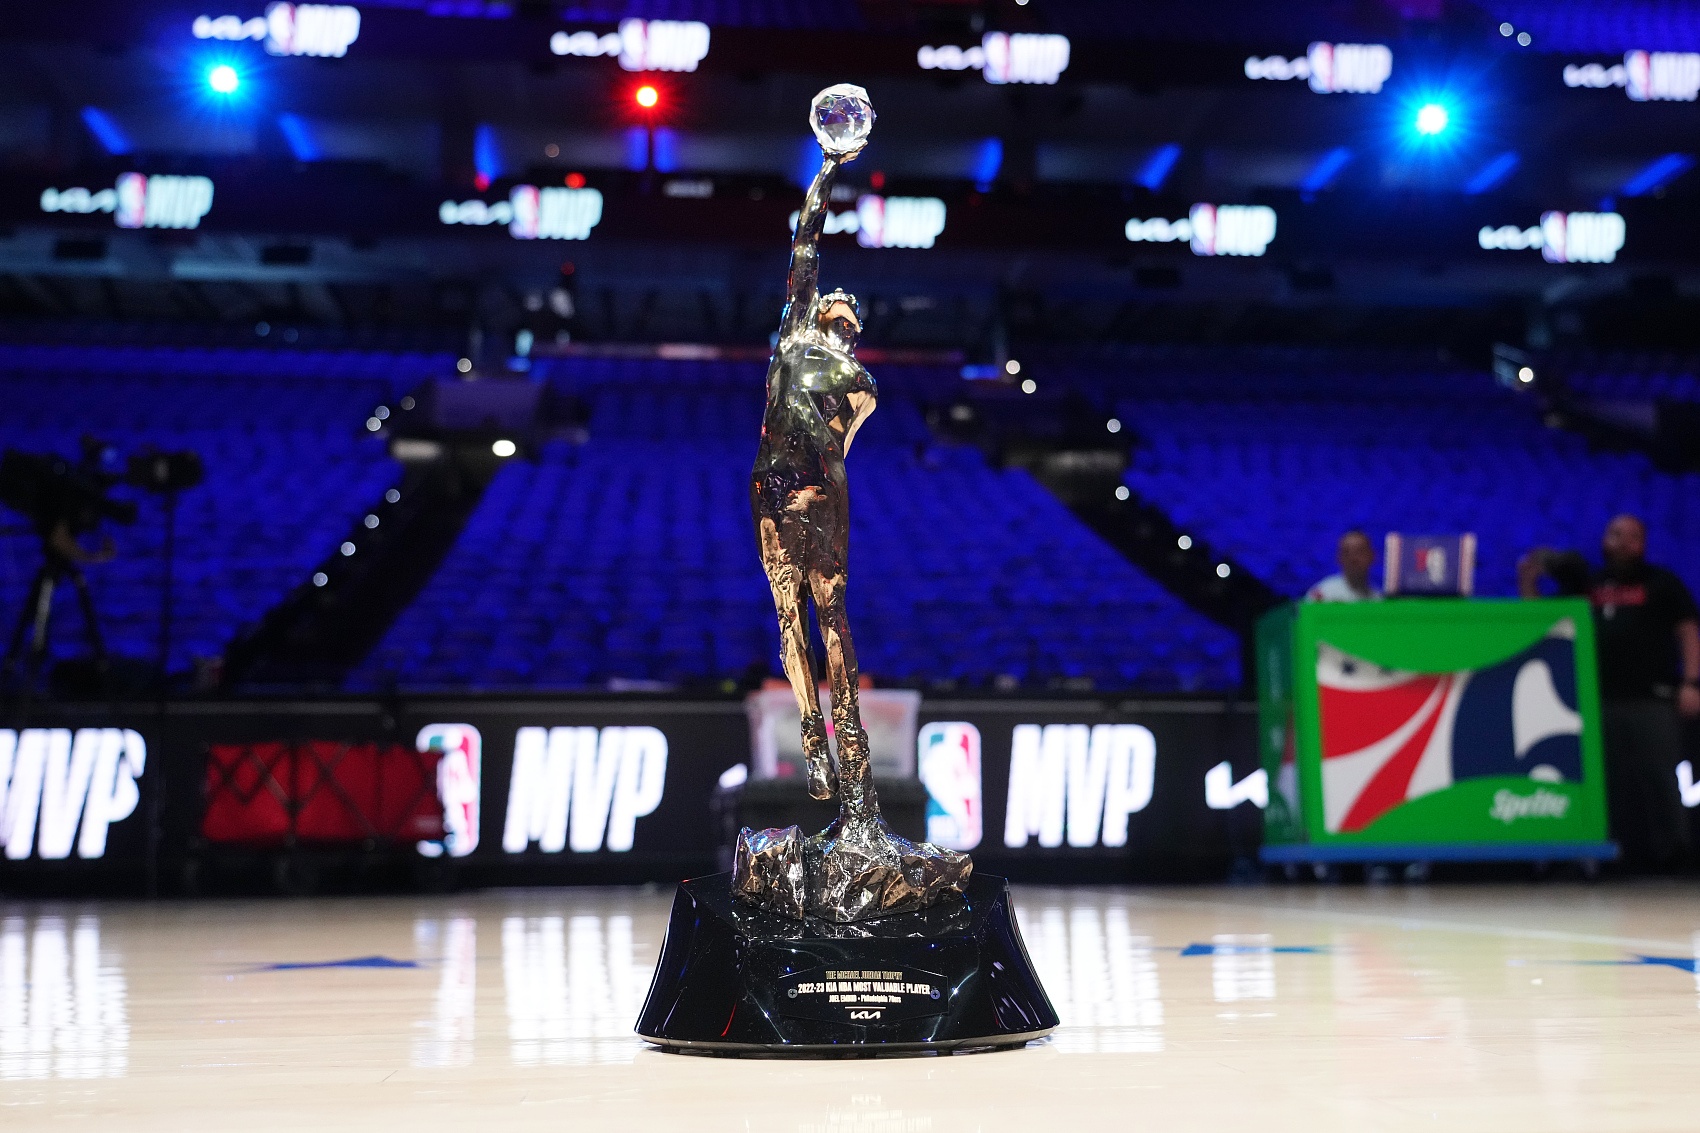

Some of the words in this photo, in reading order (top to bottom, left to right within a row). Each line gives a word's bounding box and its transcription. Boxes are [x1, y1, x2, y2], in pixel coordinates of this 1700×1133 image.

[502, 726, 668, 852] MVP
[1004, 724, 1156, 848] MVP
[1489, 788, 1570, 825] Sprite
[798, 982, 824, 993] 2022-23
[825, 981, 837, 992] KIA
[838, 981, 852, 992] NBA
[853, 981, 871, 992] MOST
[872, 982, 905, 993] VALUABLE
[906, 983, 930, 994] PLAYER
[829, 994, 840, 1002] JOEL
